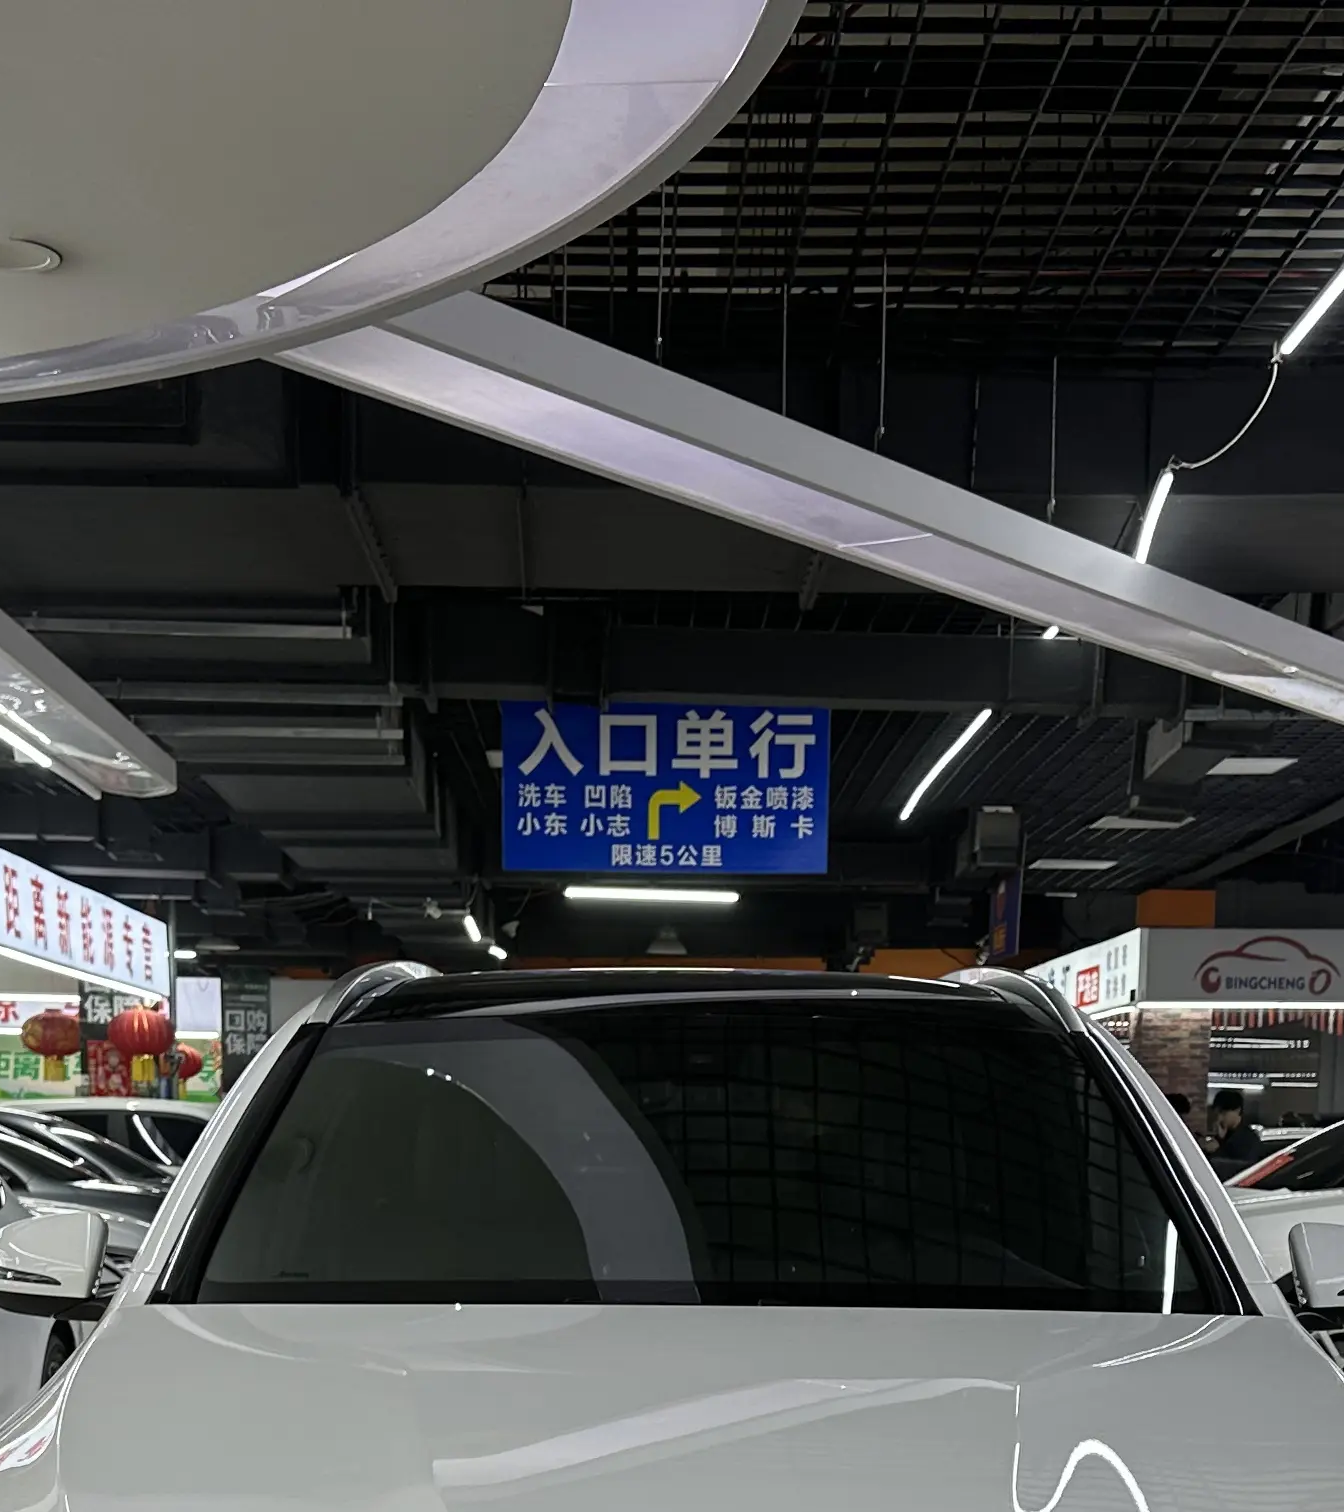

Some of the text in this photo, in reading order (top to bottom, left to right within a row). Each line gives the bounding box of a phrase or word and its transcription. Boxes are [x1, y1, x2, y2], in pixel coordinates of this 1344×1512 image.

[517, 708, 817, 779] 入口单行
[517, 782, 815, 811] 洗车 凹陷 钣金喷漆
[517, 813, 815, 839] 小东 小志 博斯卡
[611, 843, 723, 867] 限速5公里
[1224, 976, 1306, 992] BINGCHENG
